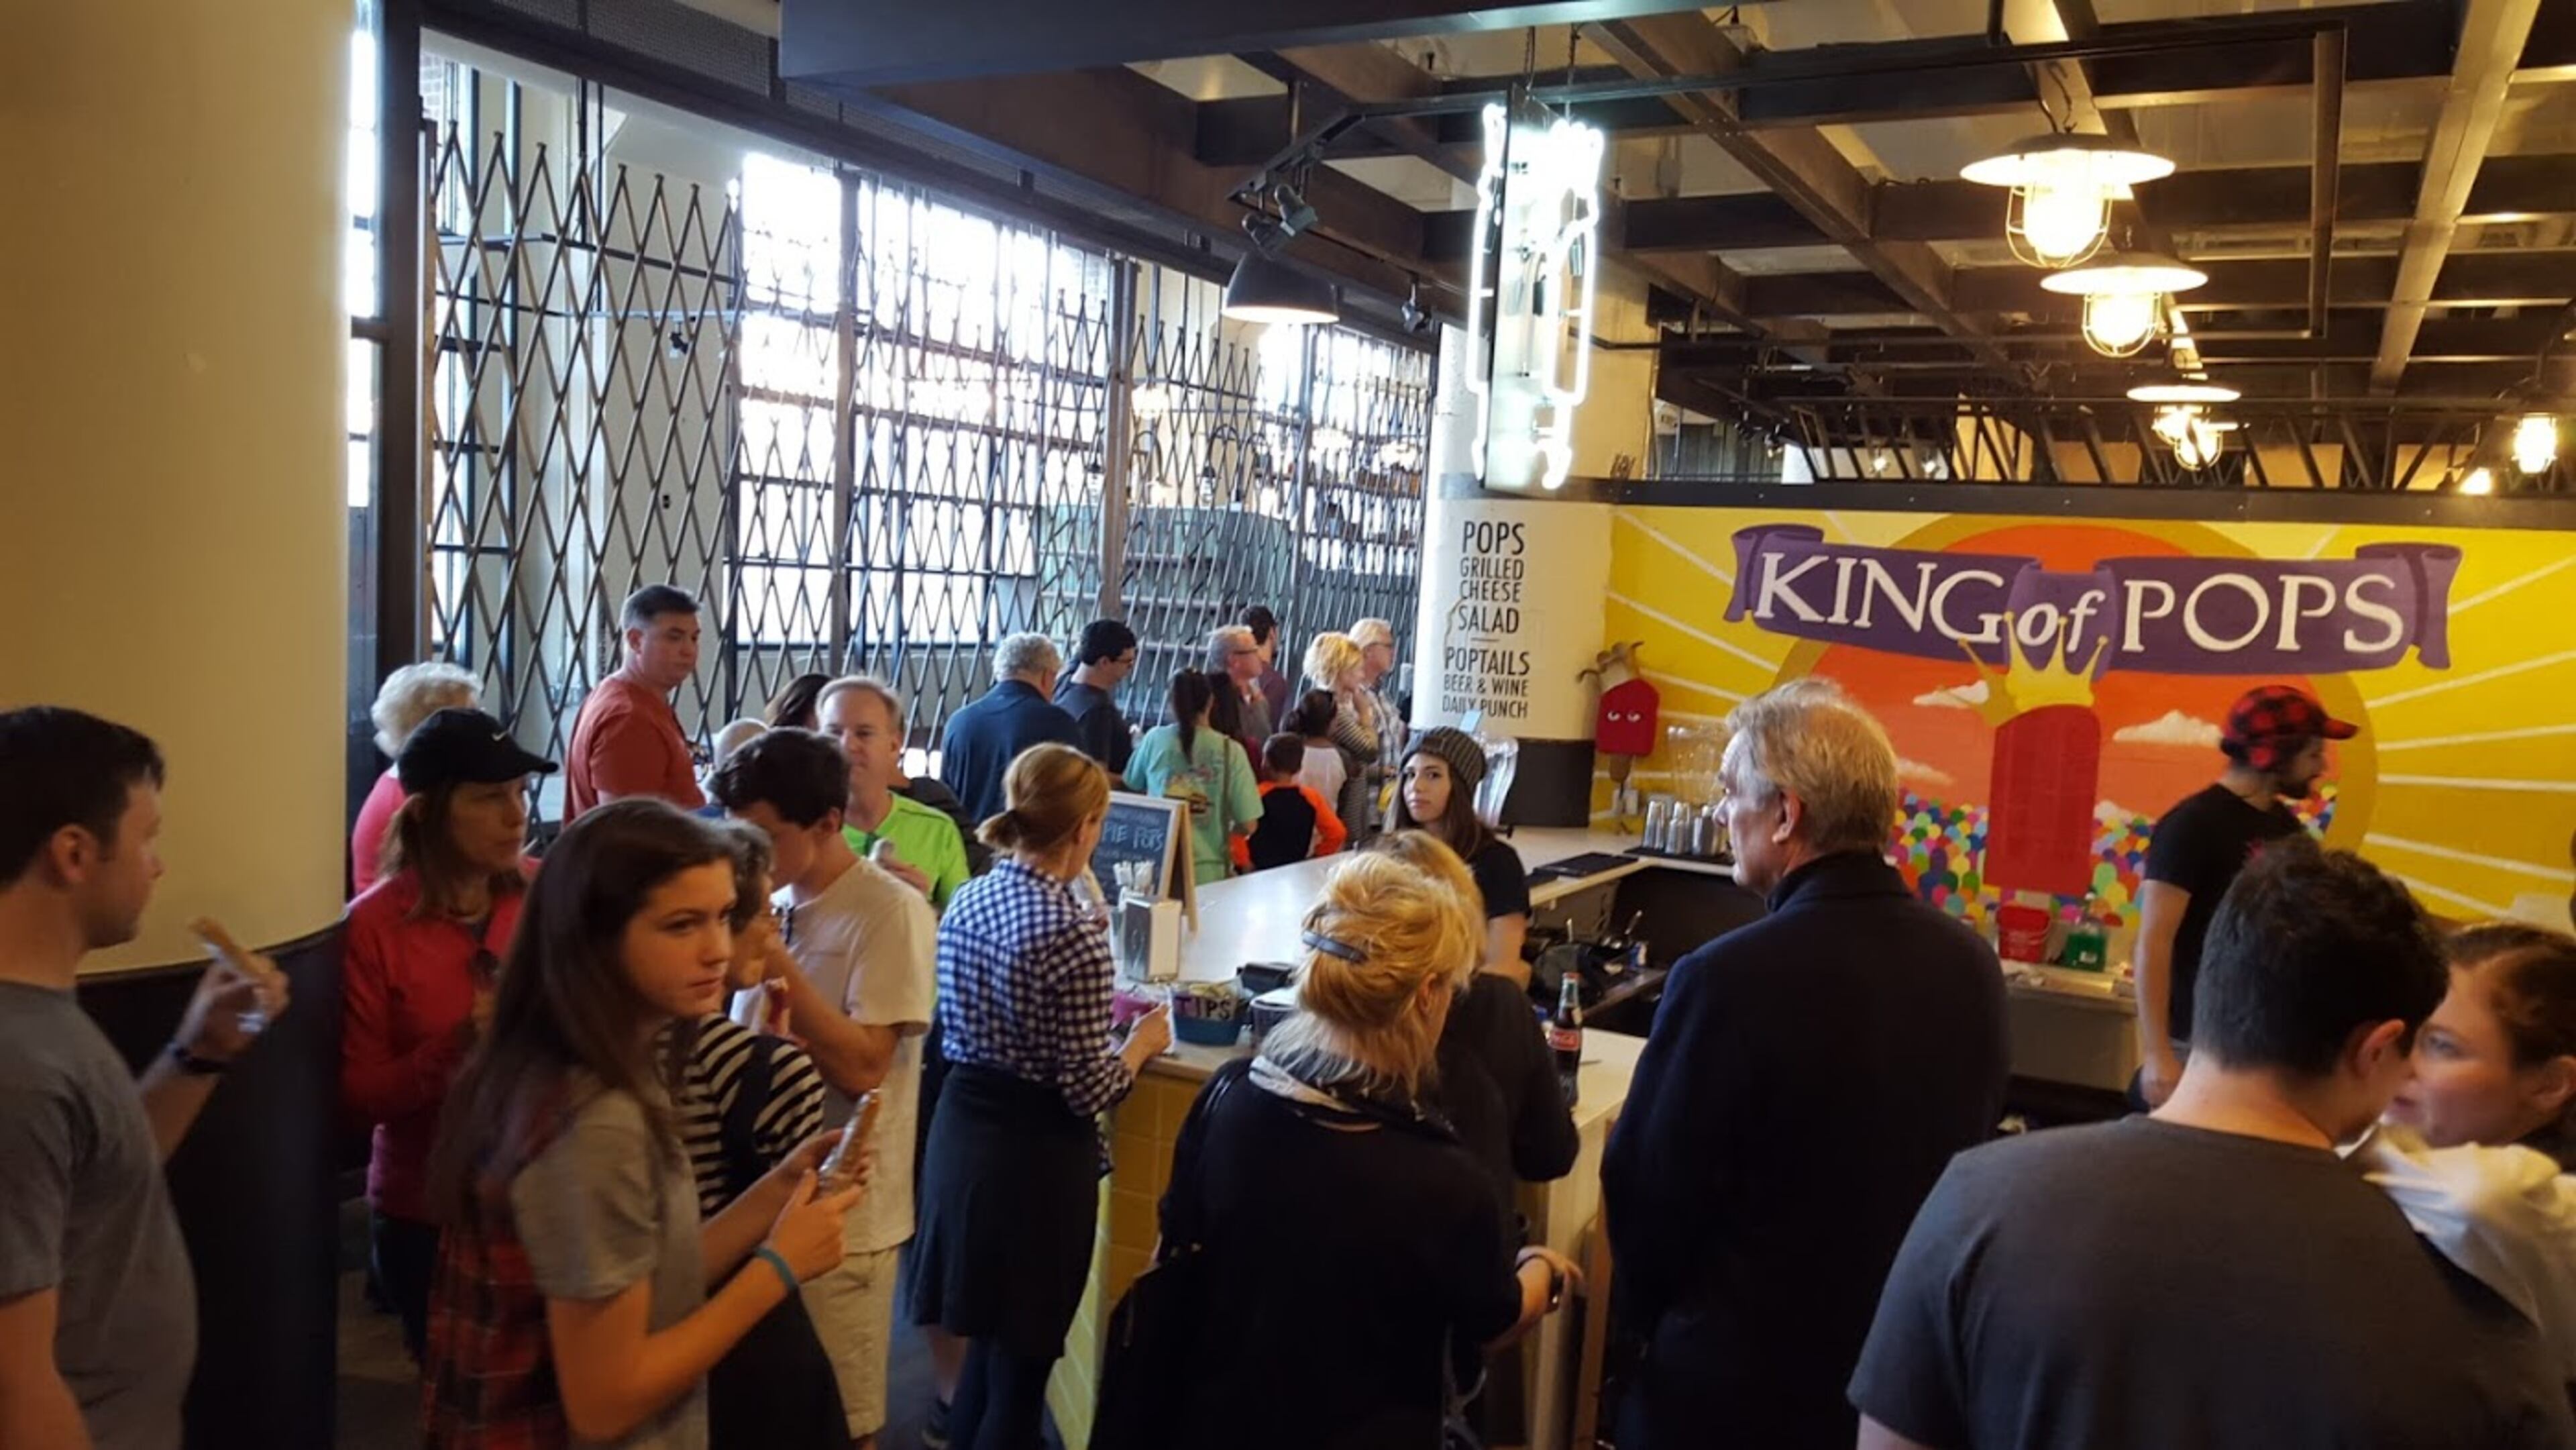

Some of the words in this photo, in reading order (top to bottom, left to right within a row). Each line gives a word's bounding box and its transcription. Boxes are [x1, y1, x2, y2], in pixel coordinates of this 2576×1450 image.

[1462, 521, 1525, 555] POPS
[1460, 557, 1524, 580] GRILLED
[1460, 580, 1522, 603] CHEESE
[1754, 552, 2004, 643] KING
[2017, 588, 2106, 653] of
[2121, 572, 2404, 653] POPS
[1458, 605, 1519, 634] SALAD
[1444, 646, 1530, 676] POPTAILS
[1444, 674, 1472, 694] BEER
[1477, 678, 1487, 694] &
[1491, 677, 1529, 697] WINE
[1442, 694, 1477, 714] DAILY
[1480, 698, 1528, 719] PUNCH
[1102, 821, 1128, 843] PIE
[1174, 996, 1231, 1019] TIPS
